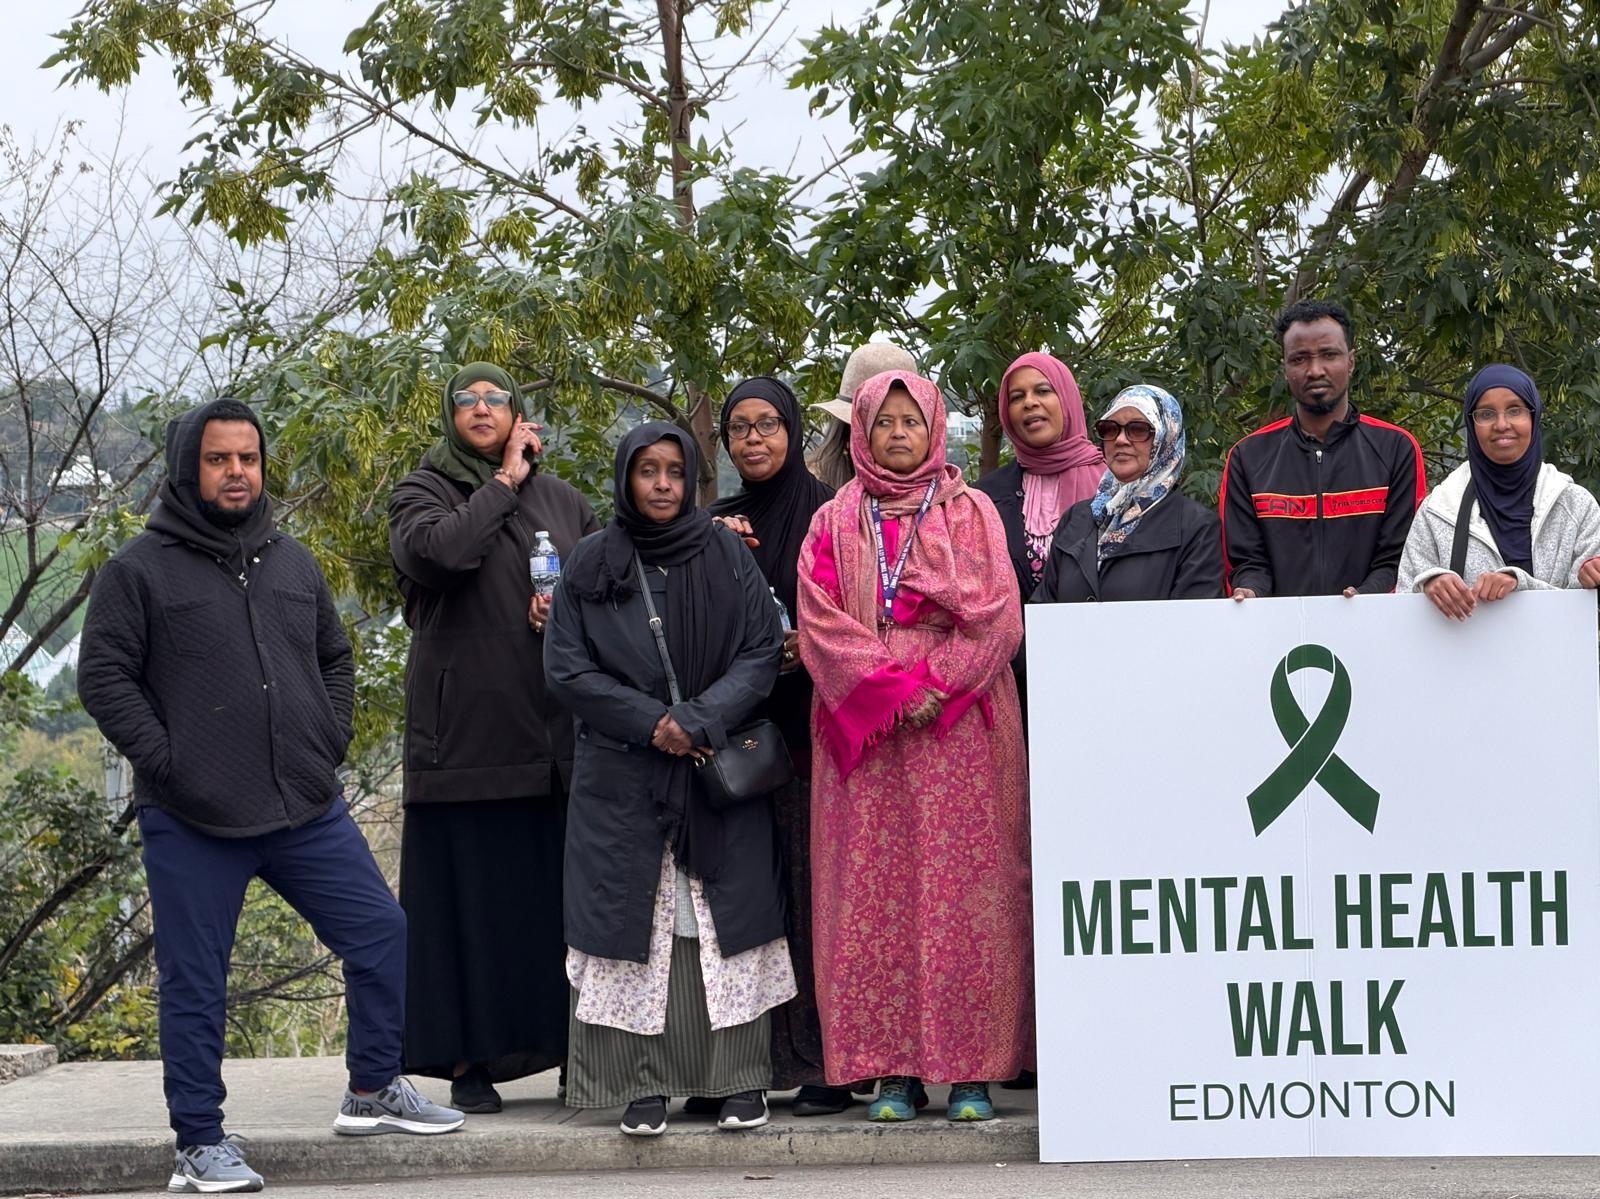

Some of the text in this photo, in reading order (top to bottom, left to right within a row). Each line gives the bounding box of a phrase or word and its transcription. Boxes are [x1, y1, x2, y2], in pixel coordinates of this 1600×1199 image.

[1254, 498, 1306, 514] CAN
[1062, 870, 1569, 956] MENTAL HEALTH
[1226, 979, 1408, 1057] WALK
[341, 1099, 373, 1116] AIR
[1170, 1080, 1455, 1121] EDMONTON
